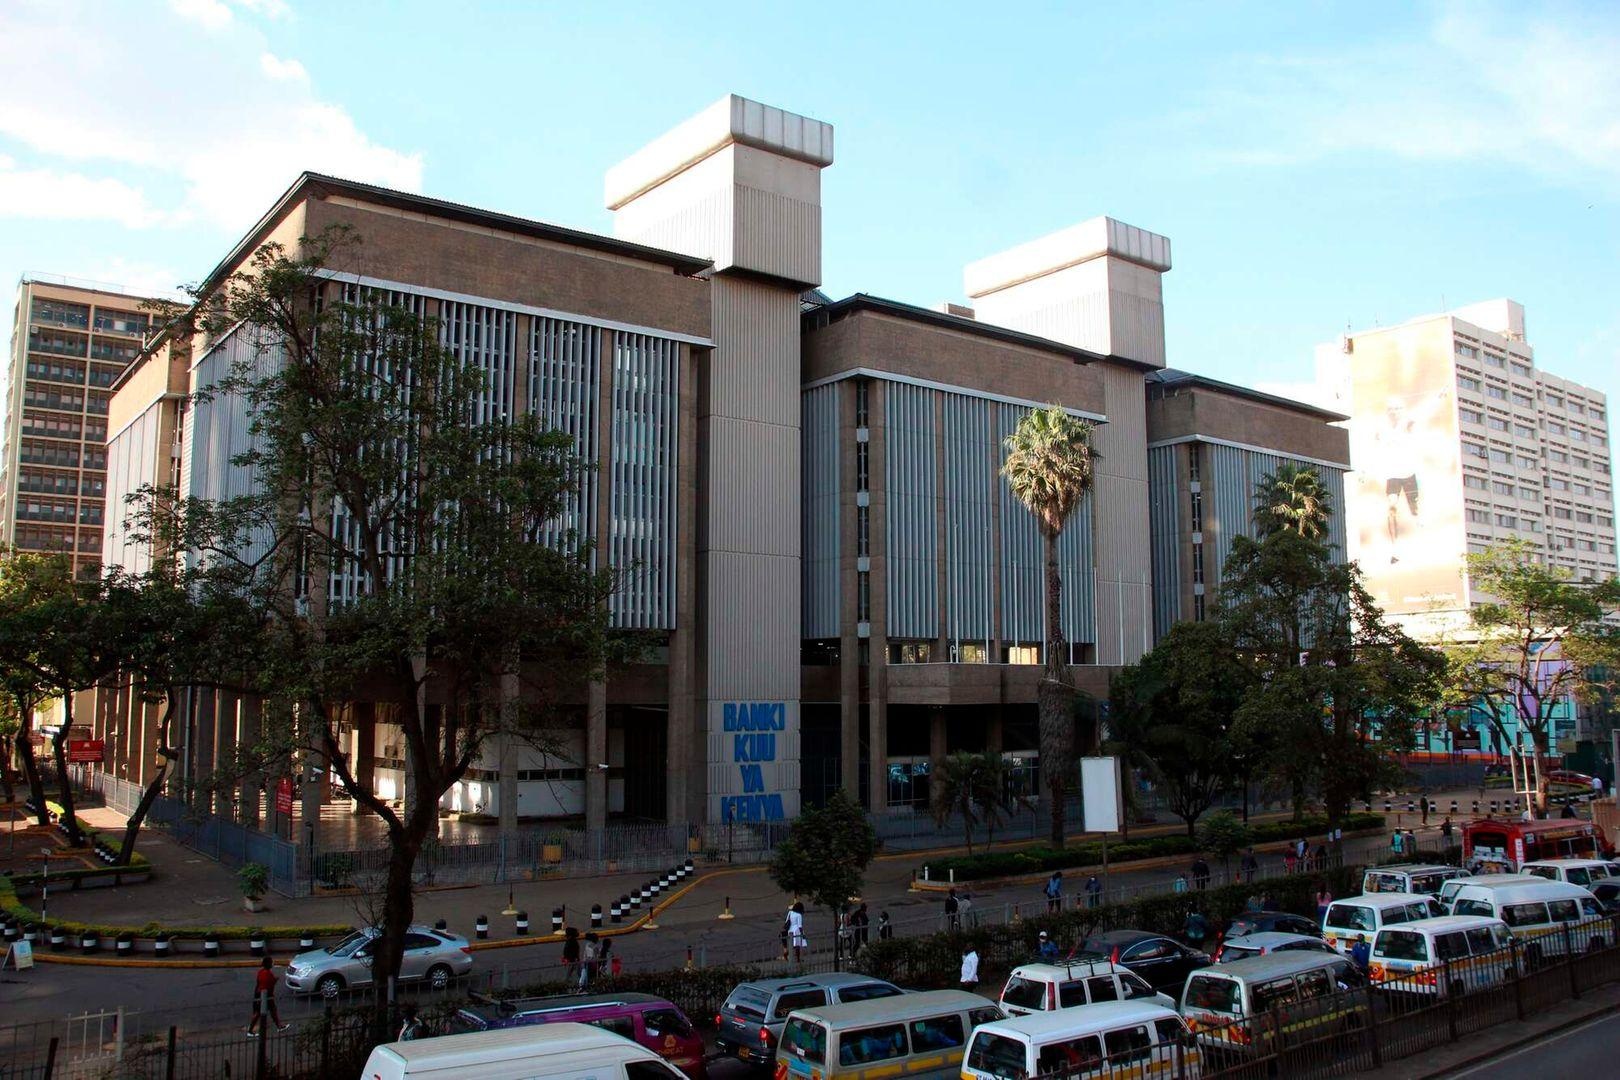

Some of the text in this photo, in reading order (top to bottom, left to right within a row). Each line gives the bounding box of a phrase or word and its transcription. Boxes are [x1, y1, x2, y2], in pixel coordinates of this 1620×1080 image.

[723, 702, 785, 731] BANKI
[734, 734, 775, 762] KUU
[740, 764, 765, 793] YA
[721, 794, 785, 825] KENYA
